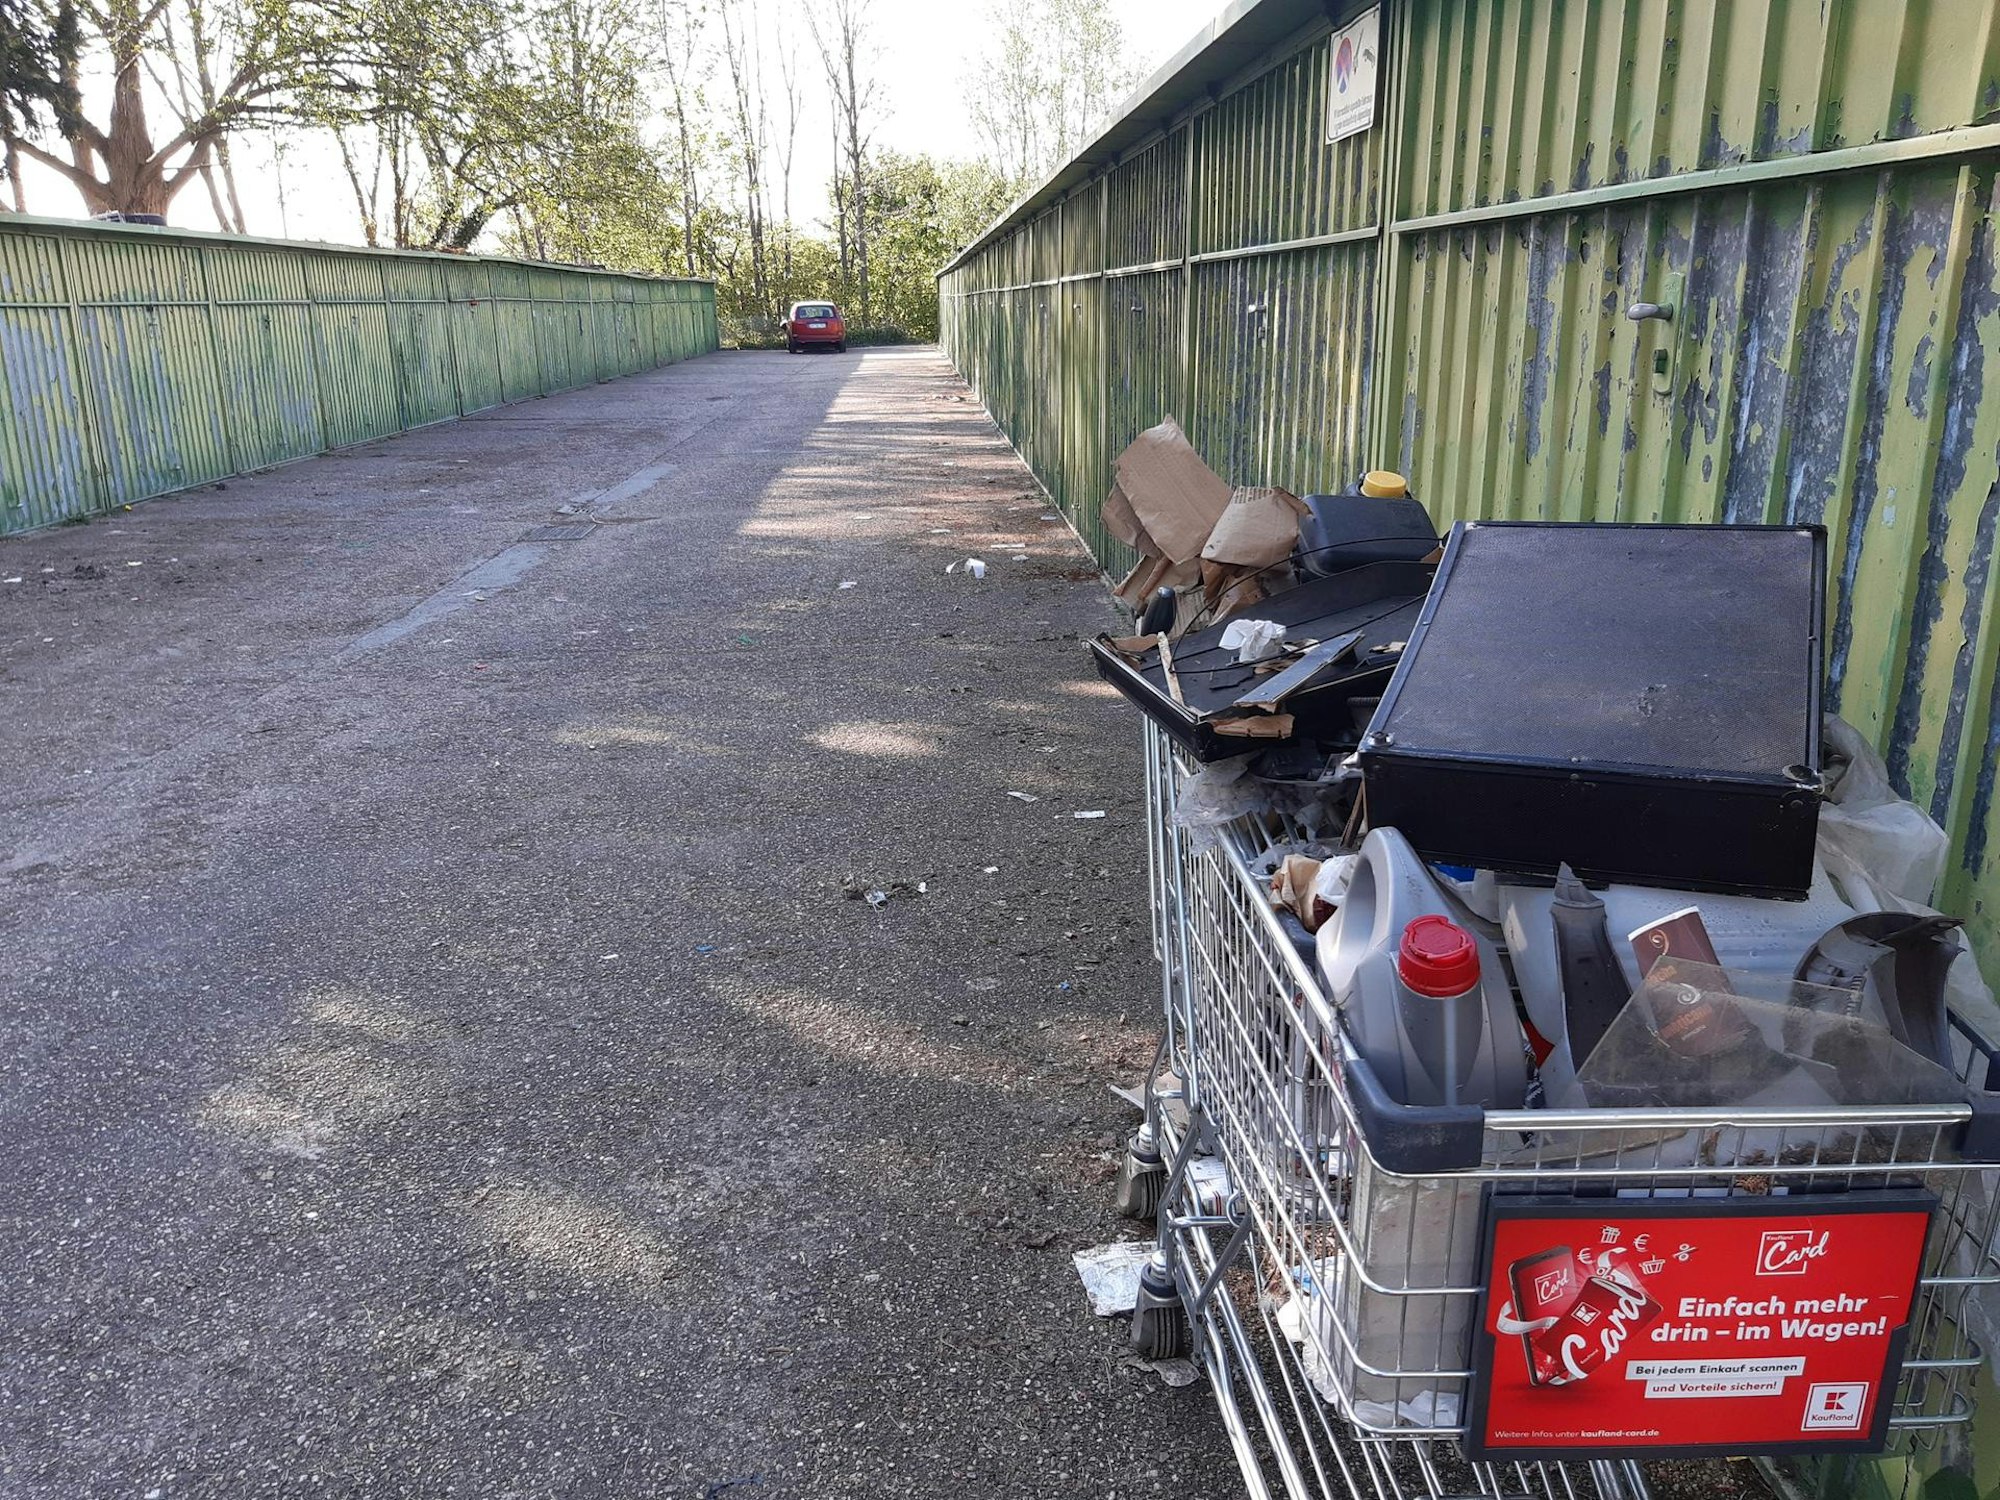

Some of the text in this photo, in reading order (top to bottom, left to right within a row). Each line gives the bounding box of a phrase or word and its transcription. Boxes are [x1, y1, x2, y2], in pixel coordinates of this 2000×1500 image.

[1764, 1231, 1829, 1271] Card
[1540, 1268, 1569, 1301] Card
[1678, 1293, 1868, 1318] Einfach mehr
[1561, 1279, 1647, 1379] Card
[1651, 1322, 1708, 1342] drin
[1736, 1322, 1770, 1341] im
[1780, 1316, 1887, 1342] Wagen!
[1635, 1363, 1798, 1376] Bei jedem Einkauf scannen
[1652, 1381, 1777, 1393] und Vorteile sichern!
[1811, 1413, 1854, 1421] Kaufland
[1494, 1429, 1660, 1438] Weitere Infos unter kaufland-card.de
